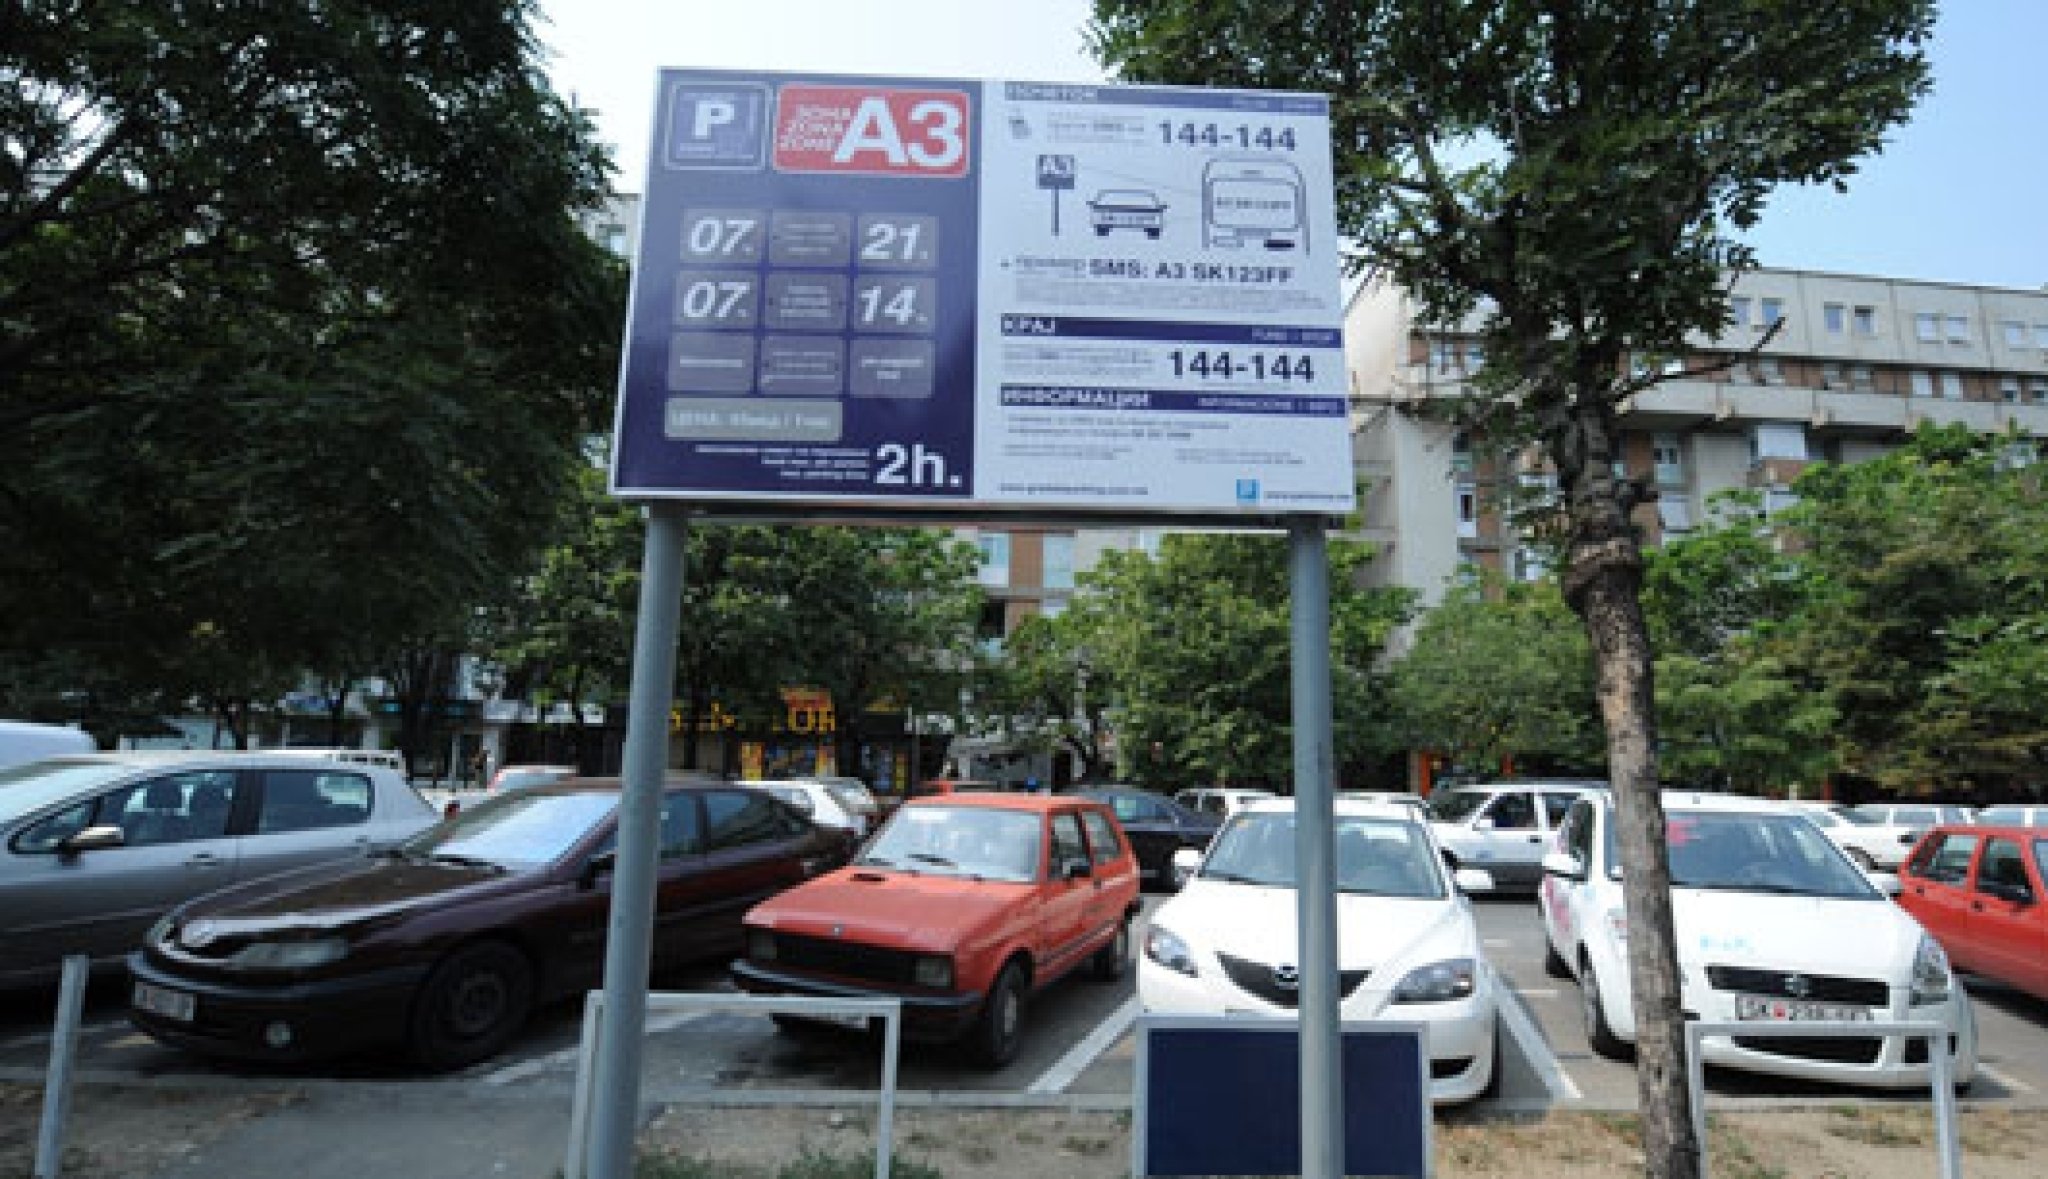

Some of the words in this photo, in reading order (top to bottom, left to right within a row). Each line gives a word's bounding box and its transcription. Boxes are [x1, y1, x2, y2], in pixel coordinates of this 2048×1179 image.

[694, 101, 735, 139] P
[834, 97, 963, 166] A3
[1158, 119, 1297, 150] 144-144
[1089, 258, 1148, 279] SMS:
[1167, 351, 1316, 382] 144-144
[874, 443, 963, 486] 2h.
